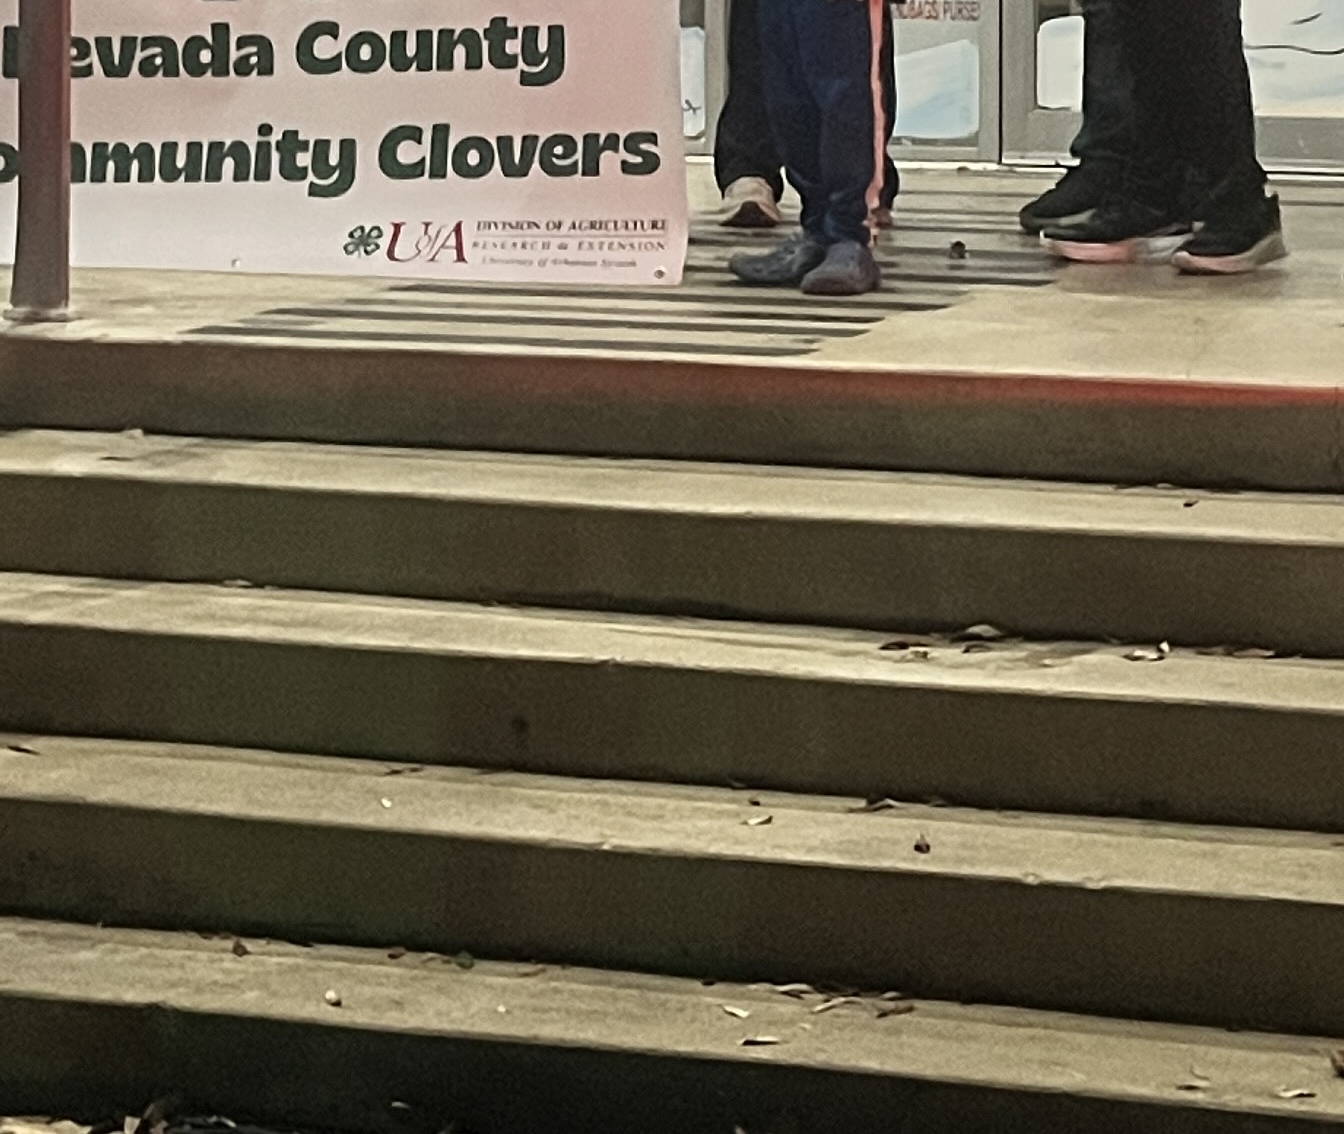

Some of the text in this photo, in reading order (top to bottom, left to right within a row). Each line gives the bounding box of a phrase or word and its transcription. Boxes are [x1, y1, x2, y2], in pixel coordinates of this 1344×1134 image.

[295, 16, 565, 86] County
[378, 123, 661, 180] Clovers
[476, 219, 667, 232] DIVISION OF AGRICULTURE
[577, 240, 666, 251] EXTENSION
